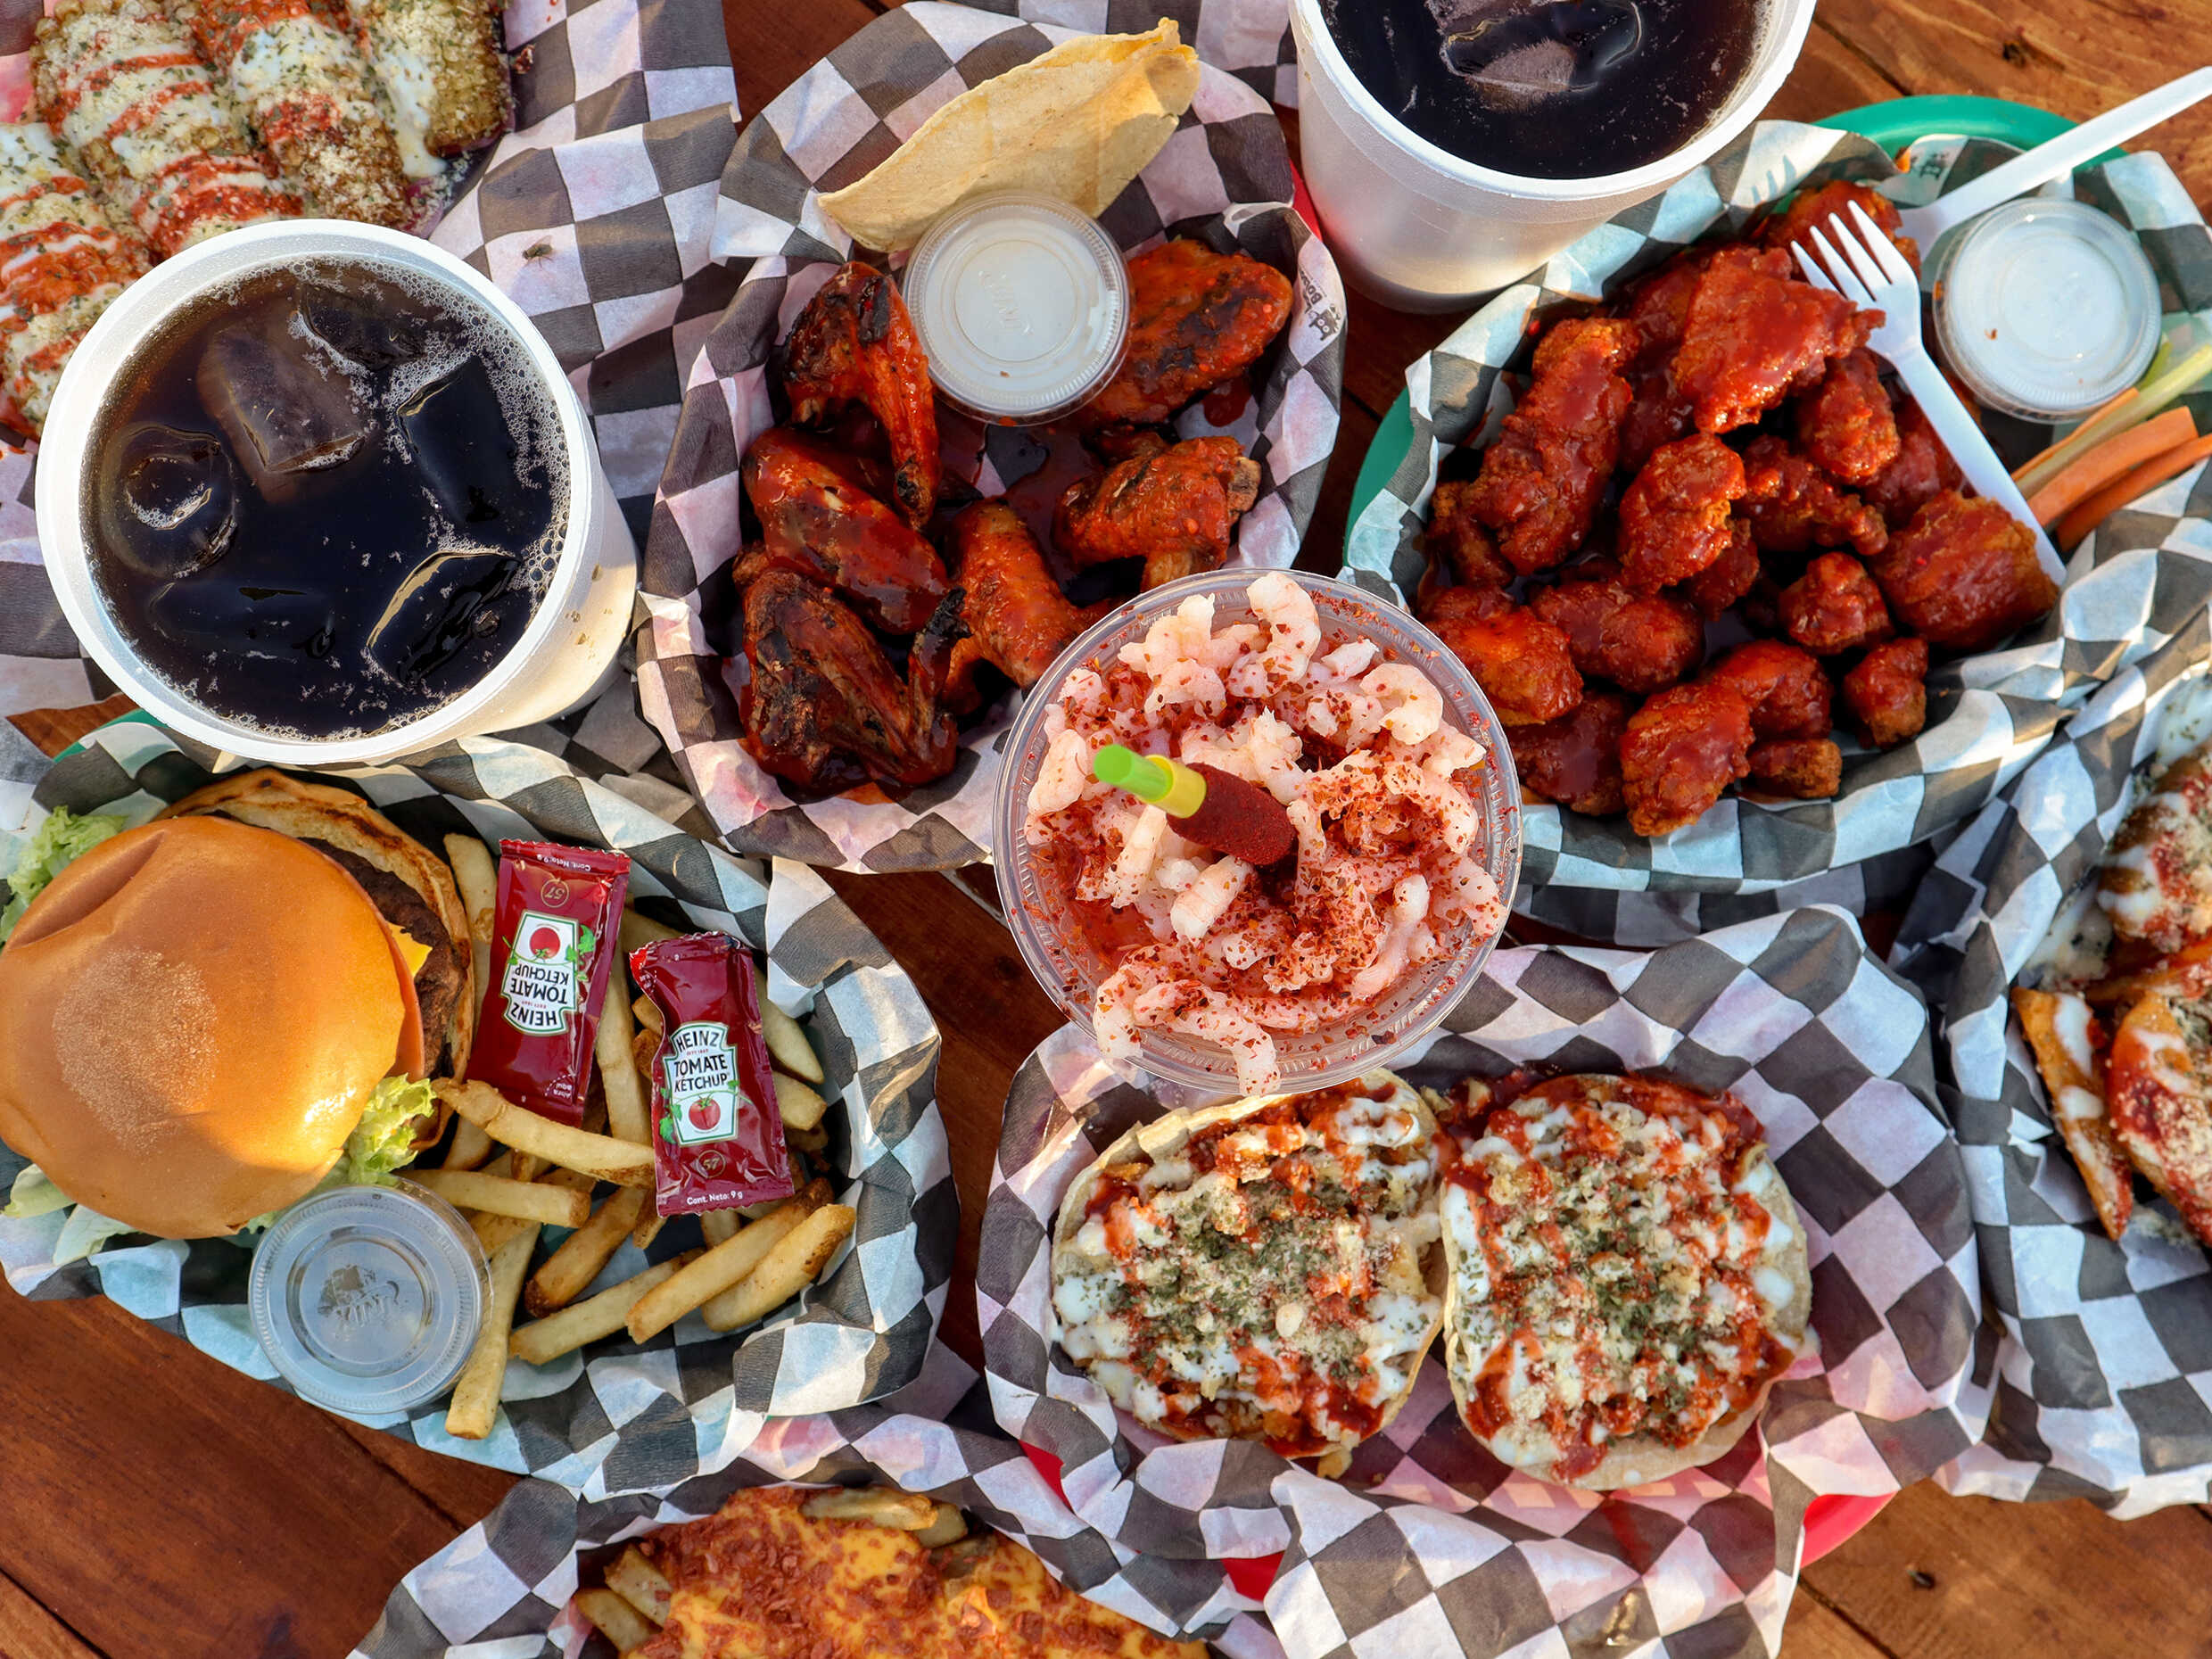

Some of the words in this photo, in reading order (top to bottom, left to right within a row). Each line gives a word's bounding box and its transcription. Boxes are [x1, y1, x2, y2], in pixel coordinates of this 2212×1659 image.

[544, 887, 565, 899] 57
[509, 978, 568, 1005] TOMATE
[510, 1002, 557, 1027] HEINZ
[676, 1030, 720, 1052] HEINZ
[673, 1054, 729, 1077] TOMATE
[703, 1157, 721, 1170] 57
[686, 1196, 708, 1206] Cont.
[708, 1193, 730, 1202] Neto:
[730, 1190, 737, 1199] 9
[737, 1191, 744, 1200] g
